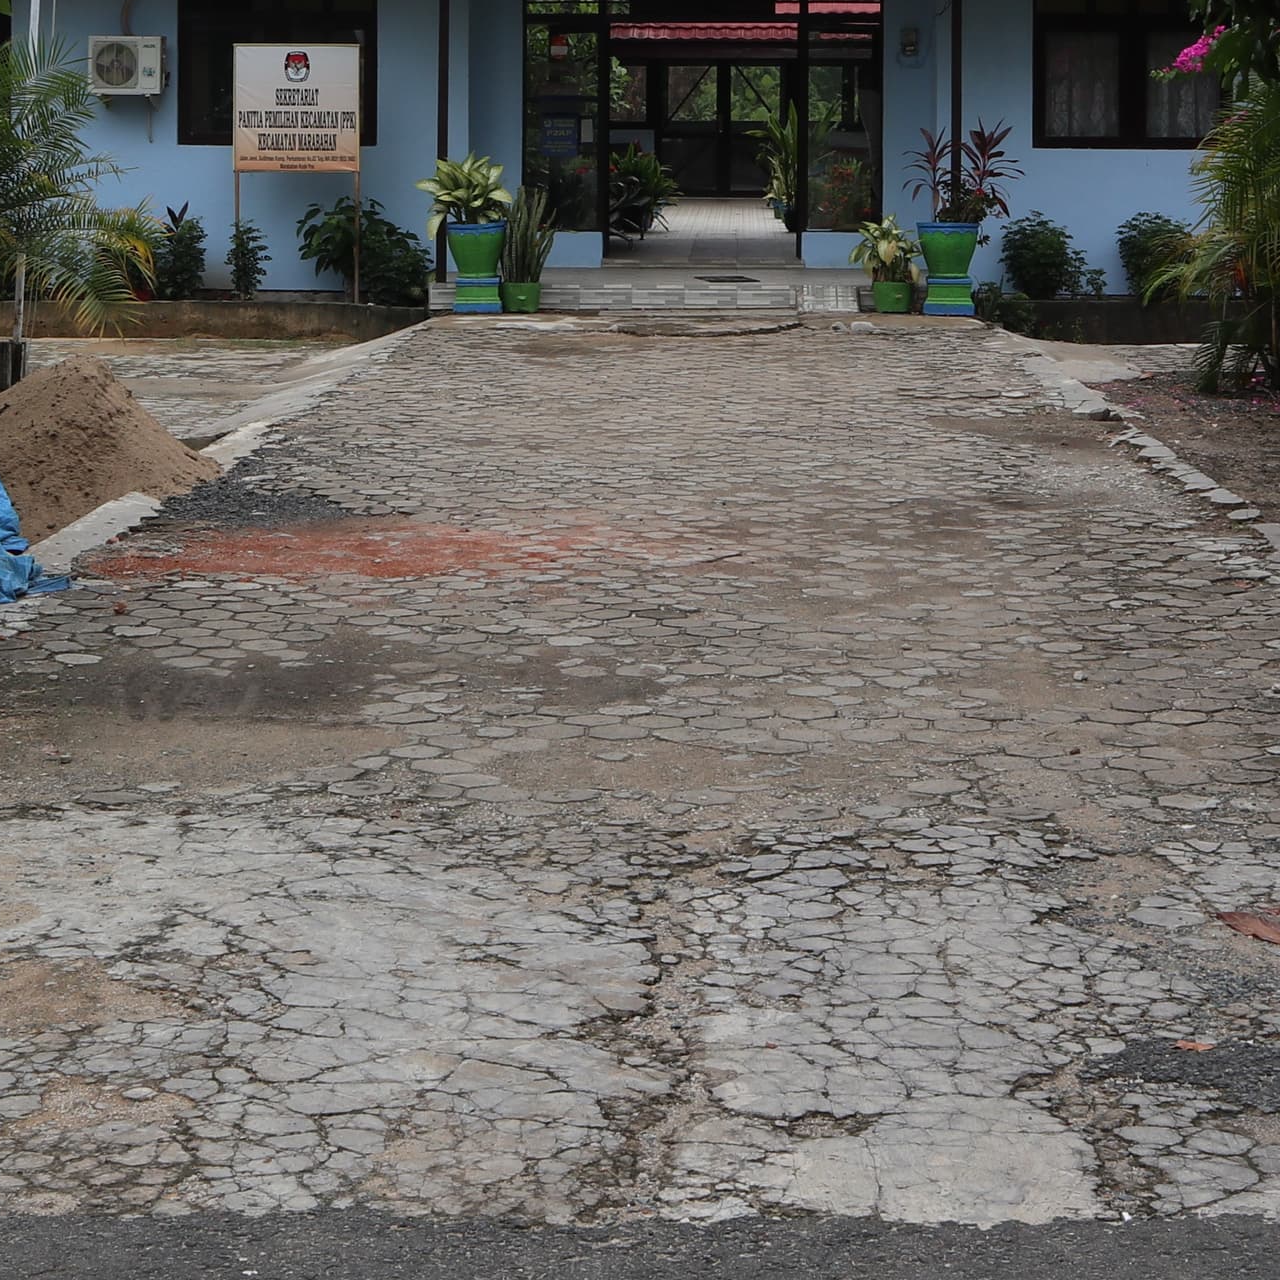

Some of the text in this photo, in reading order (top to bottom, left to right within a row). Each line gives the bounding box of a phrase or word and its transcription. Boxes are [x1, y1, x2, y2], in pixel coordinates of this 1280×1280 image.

[275, 88, 319, 106] SEKRETARIAT
[238, 111, 357, 133] PANITIA PEMILIHAN KECAMATAN (PPK)
[258, 133, 337, 151] KECAMATAN MARABAHAN
